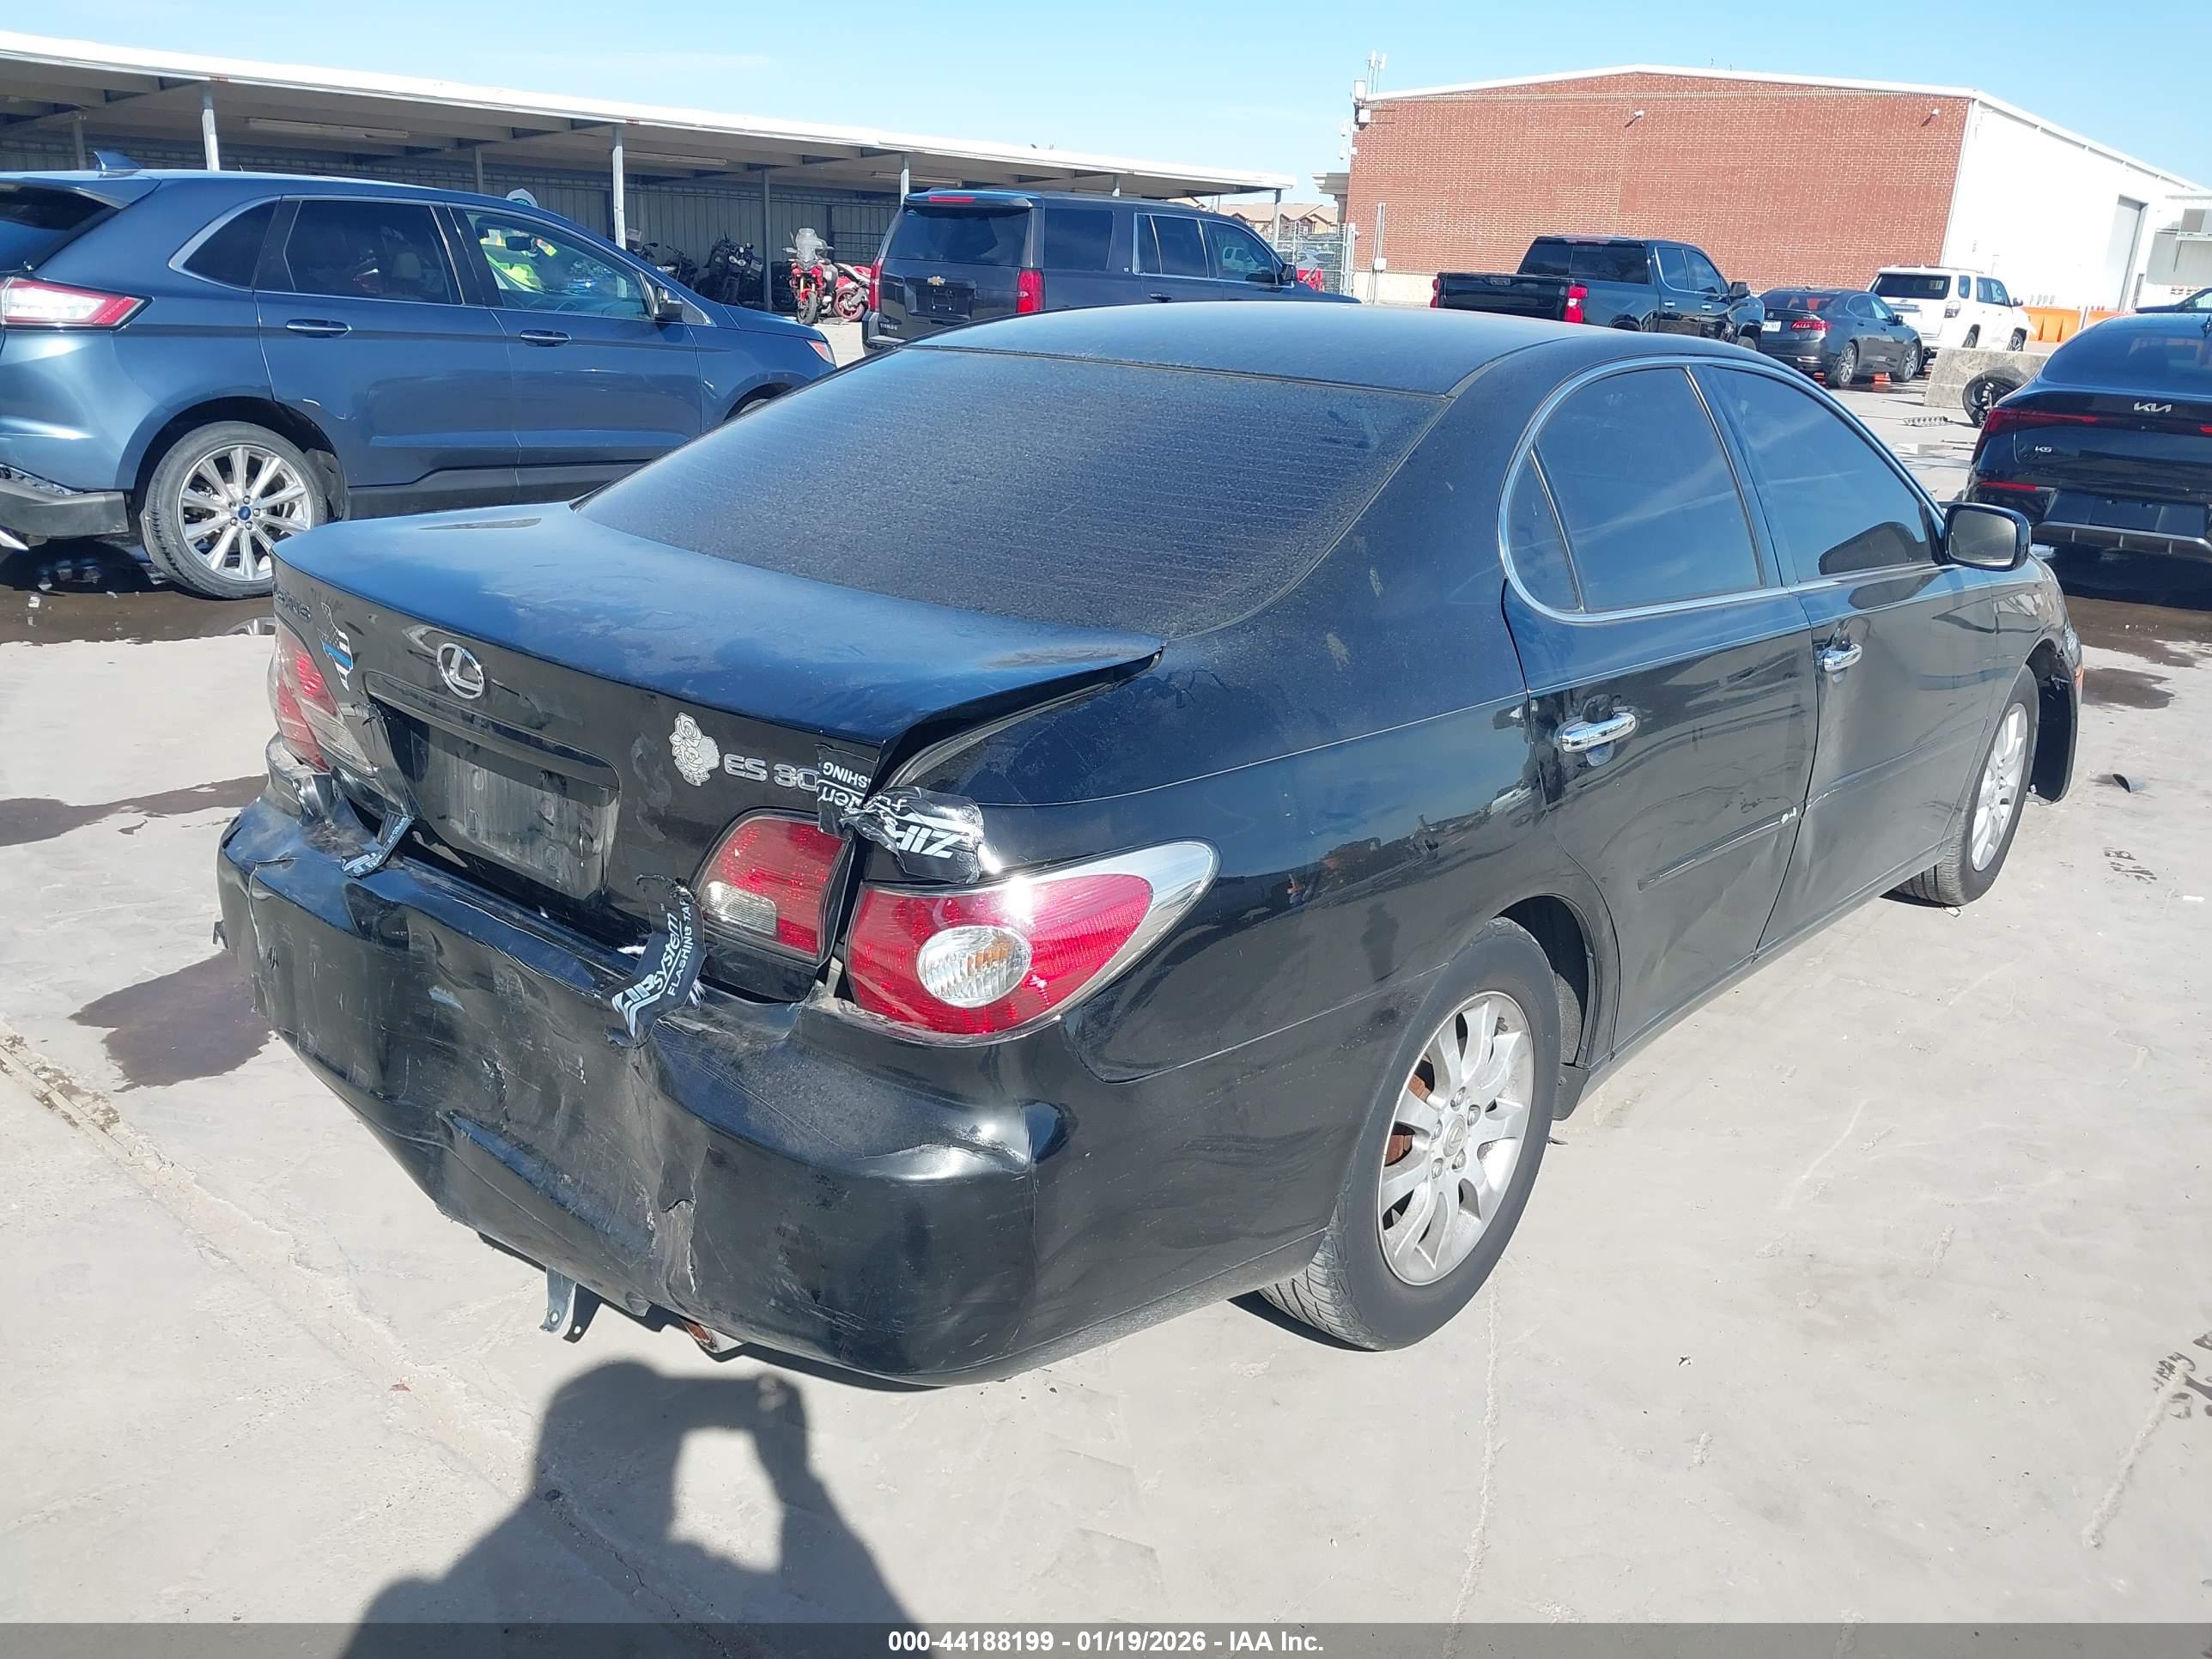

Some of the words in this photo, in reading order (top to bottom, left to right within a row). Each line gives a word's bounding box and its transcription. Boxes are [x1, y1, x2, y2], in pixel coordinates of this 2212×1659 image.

[2133, 401, 2172, 413] KIA
[724, 753, 768, 781] ES
[774, 764, 820, 792] 30
[678, 896, 693, 921] TAP
[666, 927, 694, 997] FLASHING
